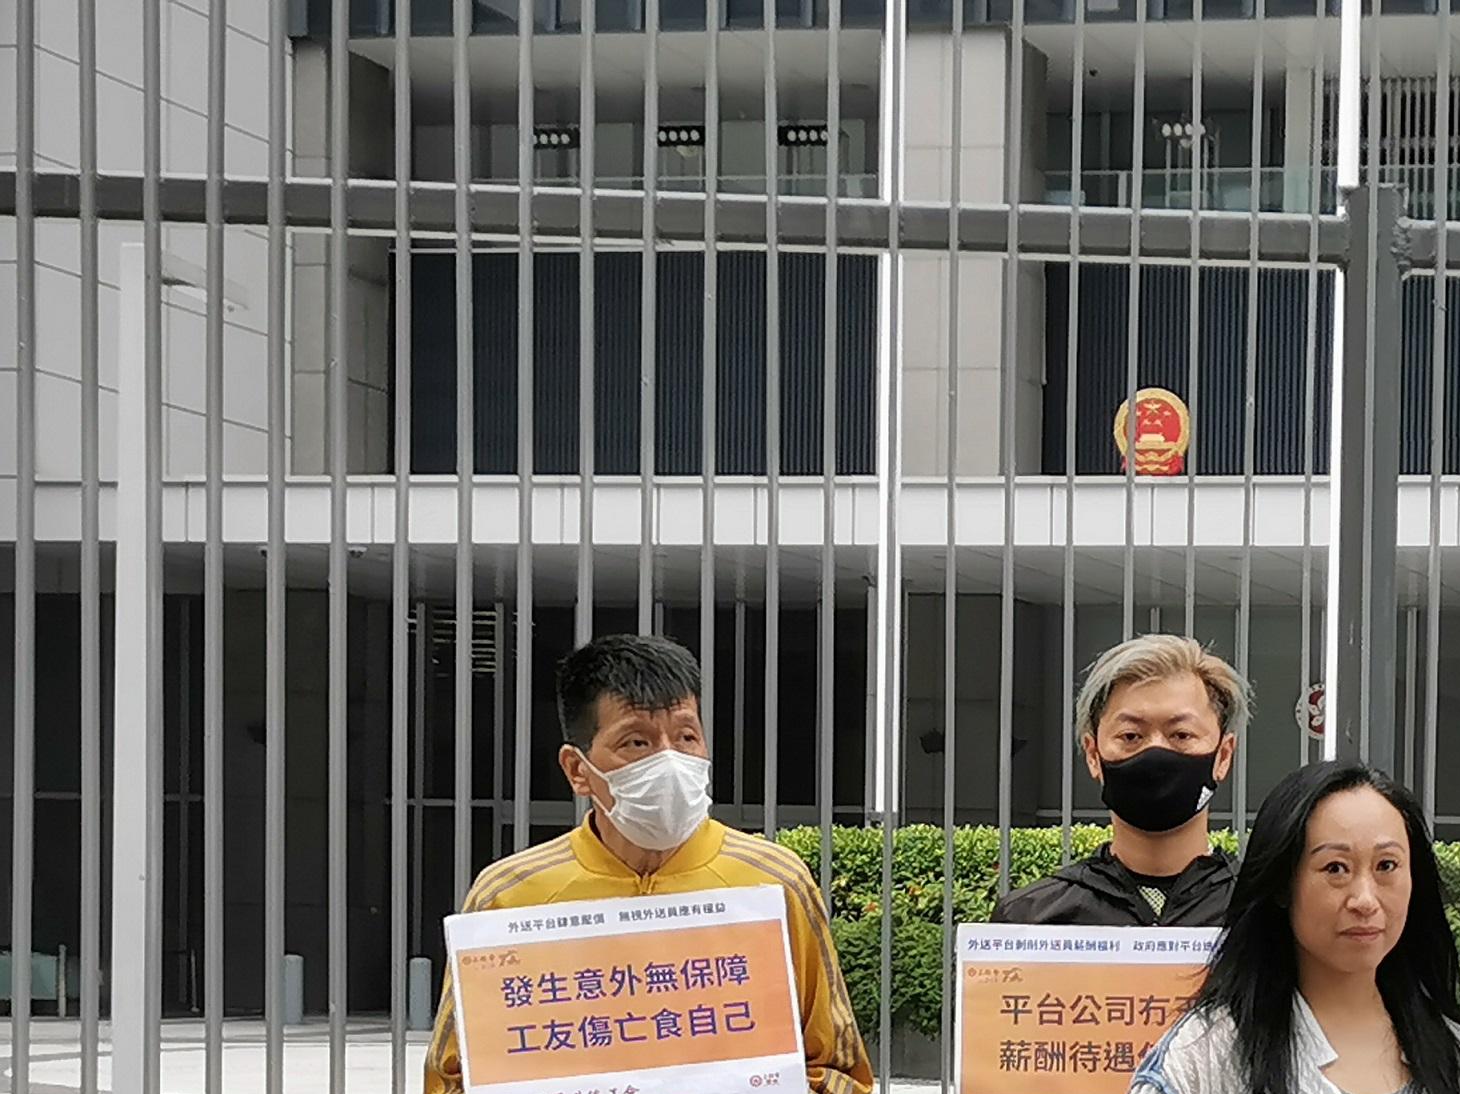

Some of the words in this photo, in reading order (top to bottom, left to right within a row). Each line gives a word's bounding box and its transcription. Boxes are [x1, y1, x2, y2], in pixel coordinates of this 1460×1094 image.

[500, 953, 750, 1009] 發生意外無保障
[506, 1000, 756, 1054] 工友傷亡食自己
